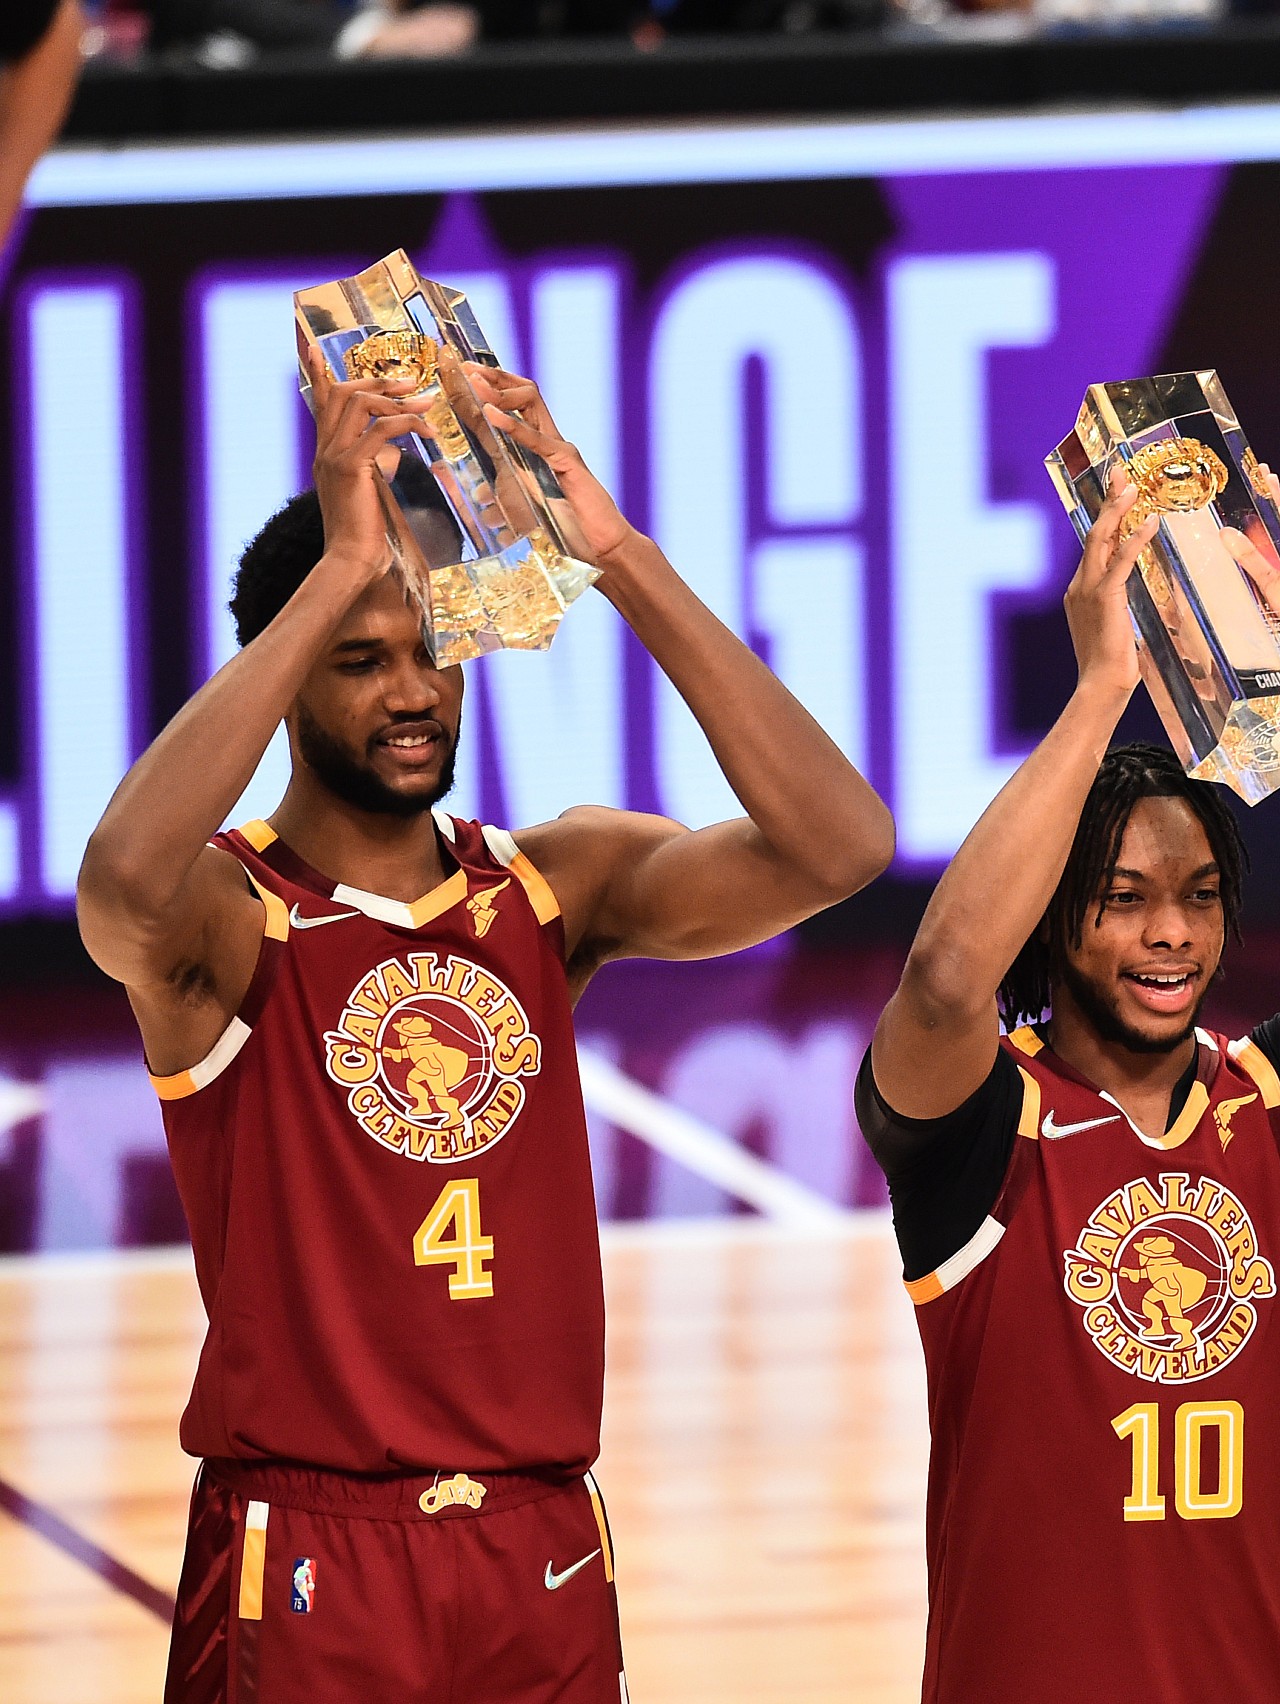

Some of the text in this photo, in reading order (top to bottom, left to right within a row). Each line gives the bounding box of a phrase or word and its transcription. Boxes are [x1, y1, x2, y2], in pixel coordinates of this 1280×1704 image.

[326, 952, 542, 1088] CAVALIERS
[348, 1078, 526, 1164] CLEVELAND
[412, 1177, 495, 1300] 4
[1064, 1172, 1277, 1307] CAVALIERS
[1083, 1299, 1258, 1385] CLEVELAND
[418, 1469, 488, 1515] CAVS
[1110, 1400, 1245, 1522] 10
[293, 1597, 303, 1611] 75
